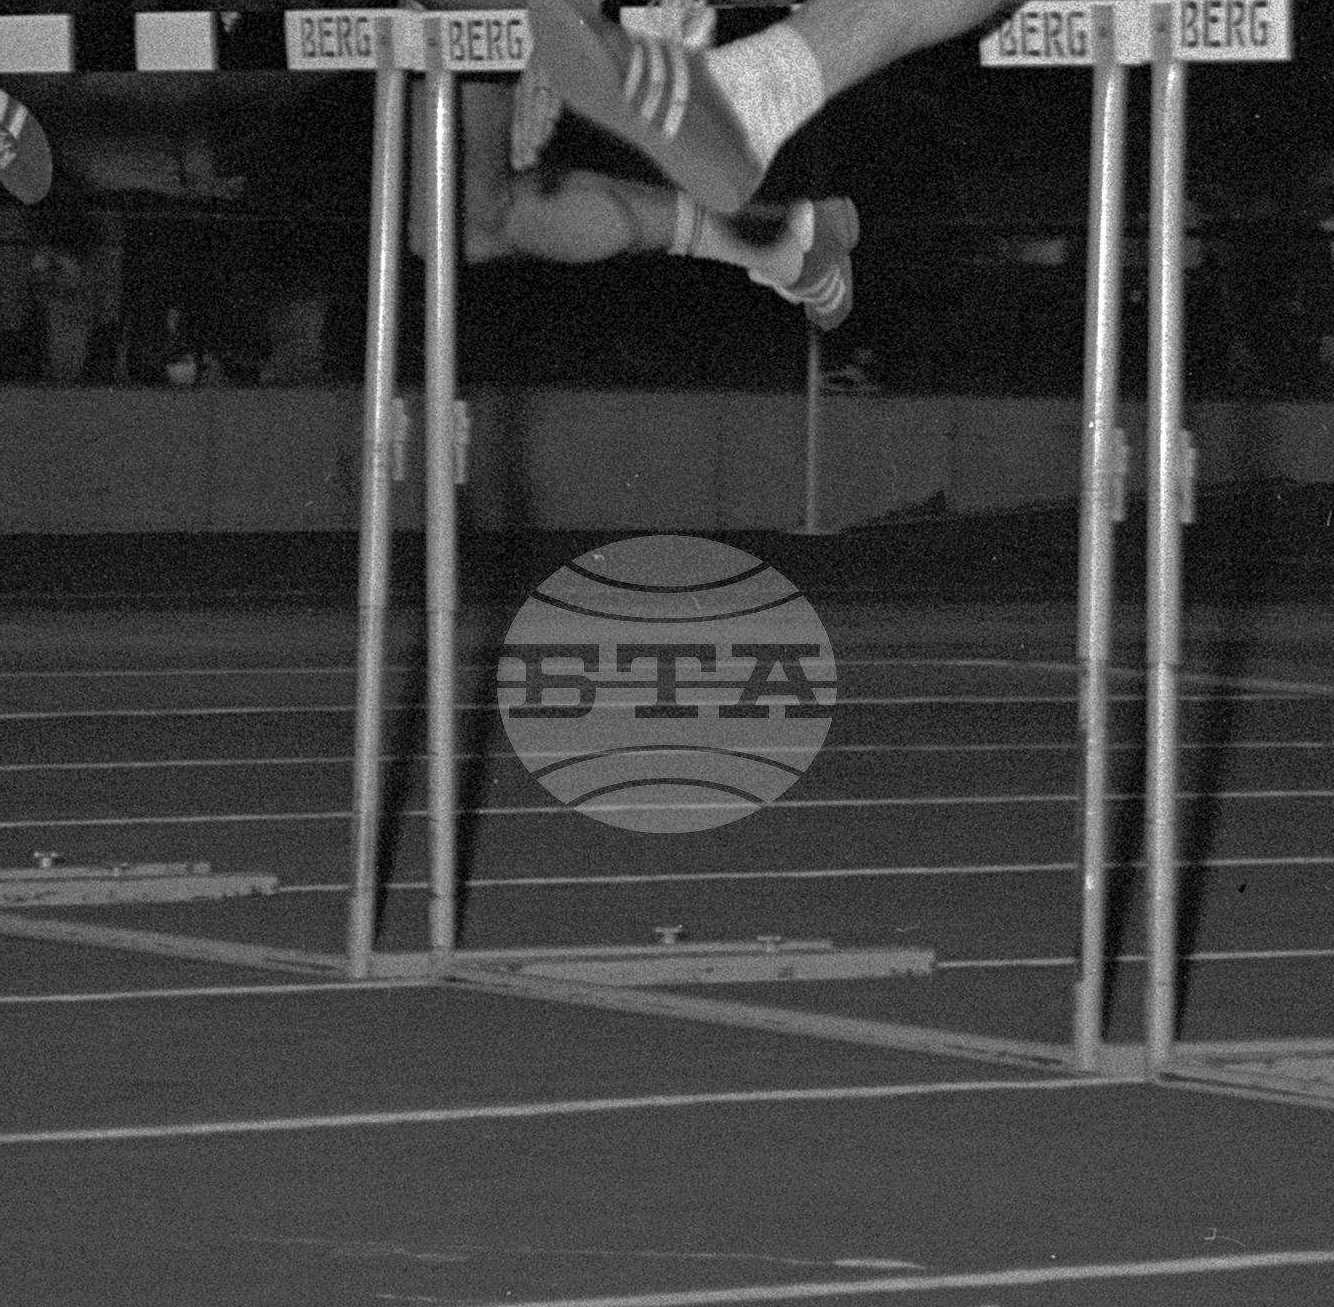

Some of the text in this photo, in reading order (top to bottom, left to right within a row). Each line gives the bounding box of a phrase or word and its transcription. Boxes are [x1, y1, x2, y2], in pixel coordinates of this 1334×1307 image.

[301, 16, 372, 58] BERG
[449, 18, 523, 61] BERG
[998, 10, 1086, 57] BERG
